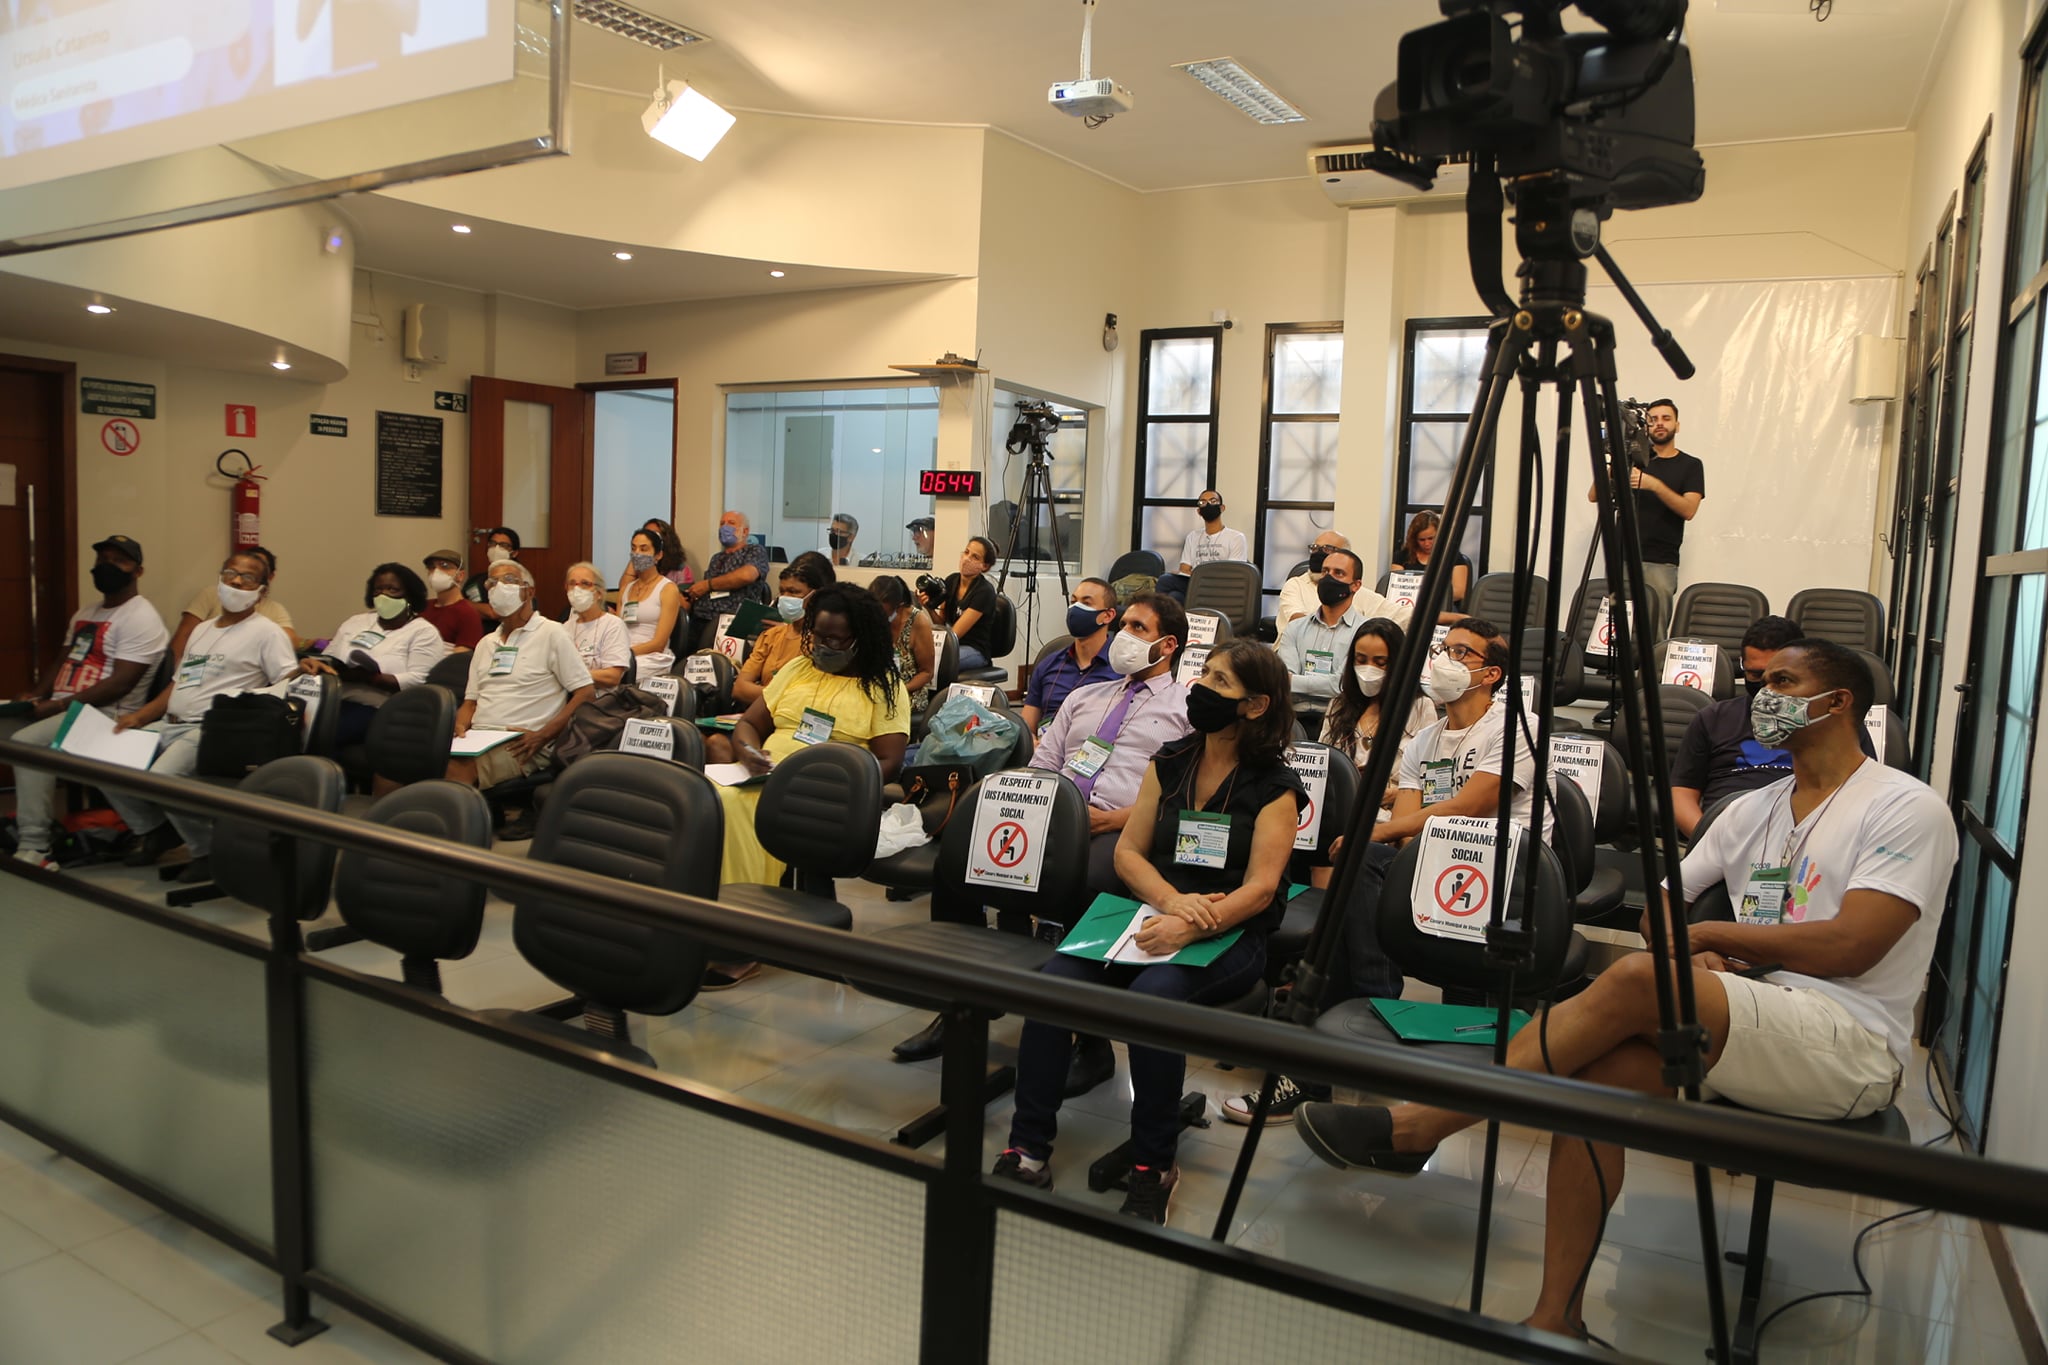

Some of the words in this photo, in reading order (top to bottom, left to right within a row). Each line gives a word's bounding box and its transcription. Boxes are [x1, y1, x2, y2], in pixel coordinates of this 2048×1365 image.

[999, 776, 1033, 790] RESPEITE
[1035, 780, 1042, 790] O
[984, 789, 1049, 806] DISTANCIAMENTO
[1000, 807, 1025, 820] SOCIAL
[1448, 818, 1490, 829] RESPEITE
[1451, 848, 1483, 864] SOCIAL
